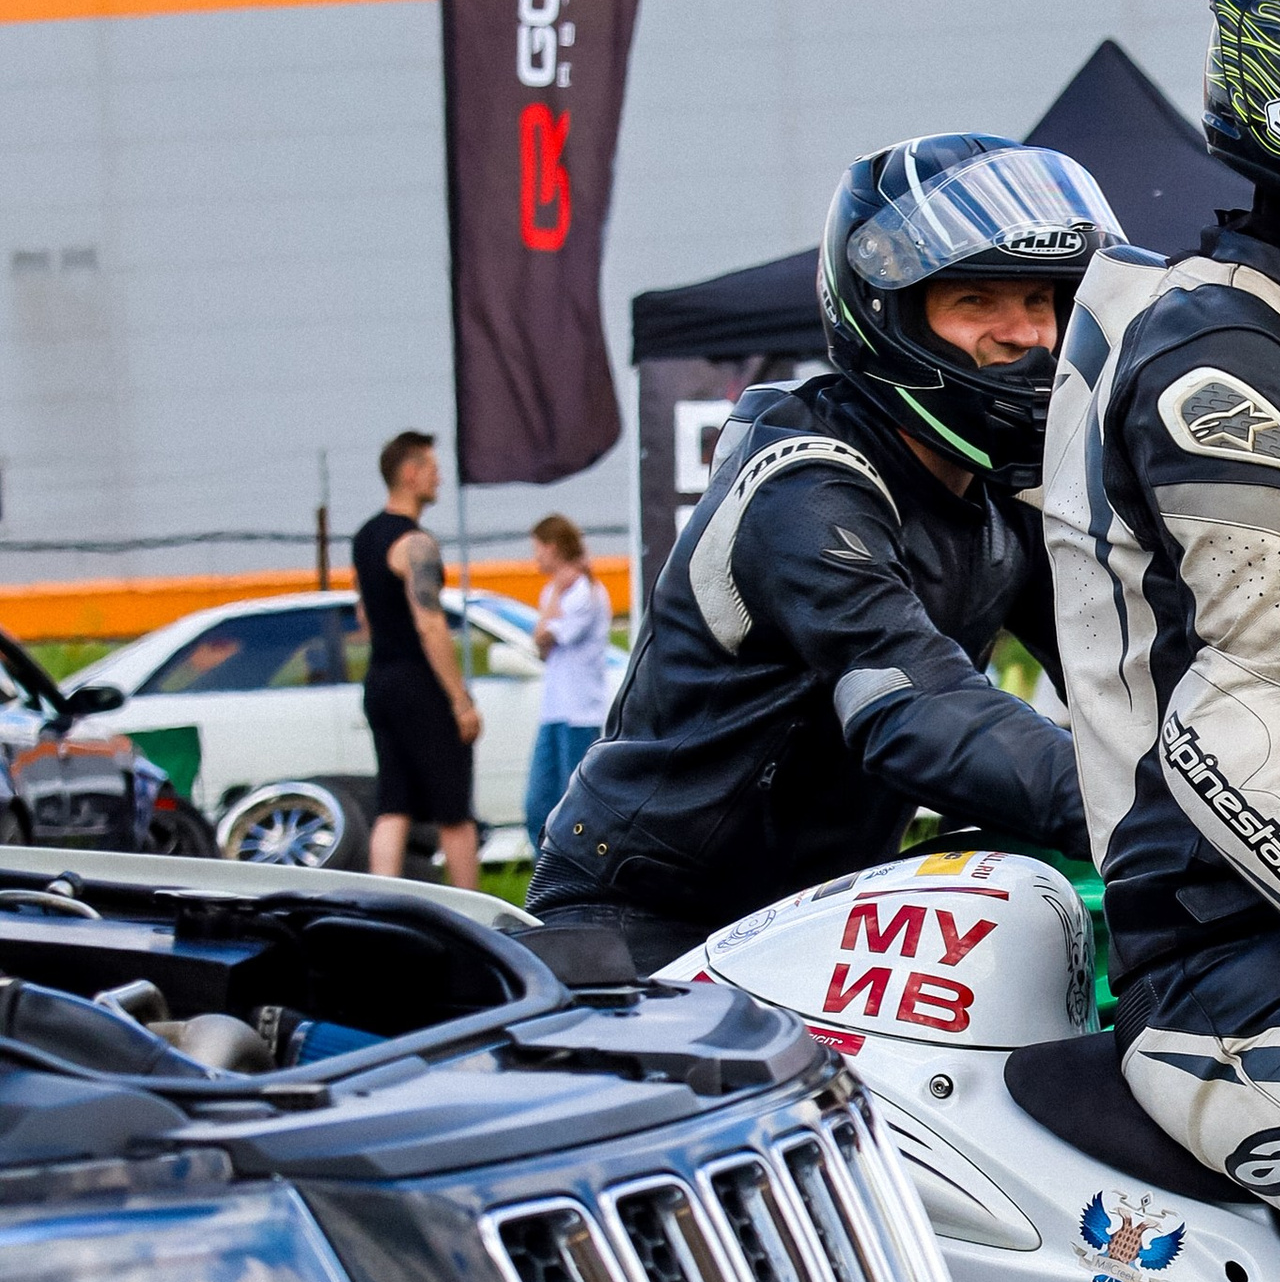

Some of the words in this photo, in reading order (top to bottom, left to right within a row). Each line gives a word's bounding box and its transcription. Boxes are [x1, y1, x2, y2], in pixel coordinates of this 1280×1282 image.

[1008, 229, 1078, 250] HJC
[841, 902, 999, 968] МУ
[822, 962, 975, 1033] ИВ
